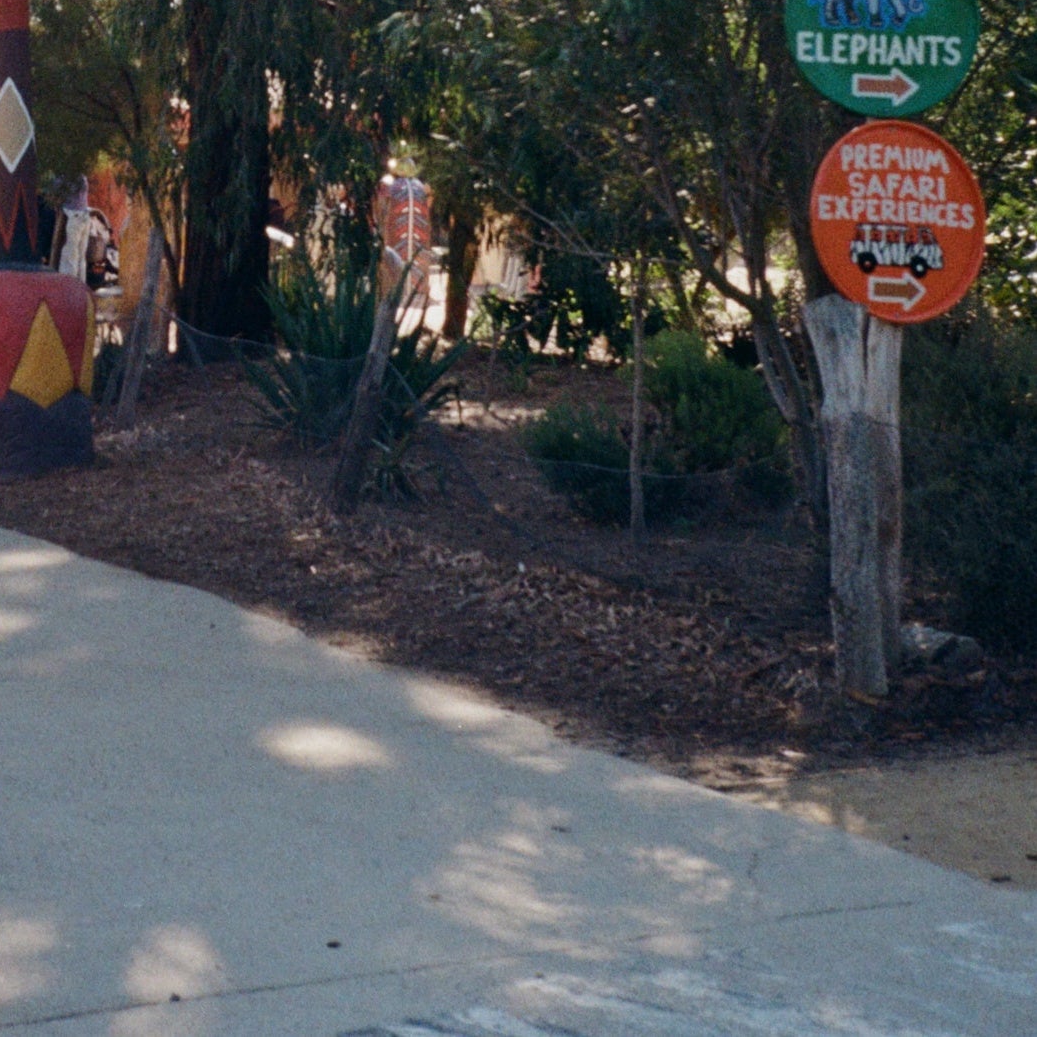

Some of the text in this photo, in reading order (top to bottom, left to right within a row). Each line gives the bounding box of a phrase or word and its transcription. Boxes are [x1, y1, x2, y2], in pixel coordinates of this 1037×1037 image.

[795, 30, 962, 66] ELEPHANTS
[840, 143, 950, 174] PREMIUM
[848, 172, 947, 202] SAFARI
[817, 194, 975, 230] EXPERIENCES
